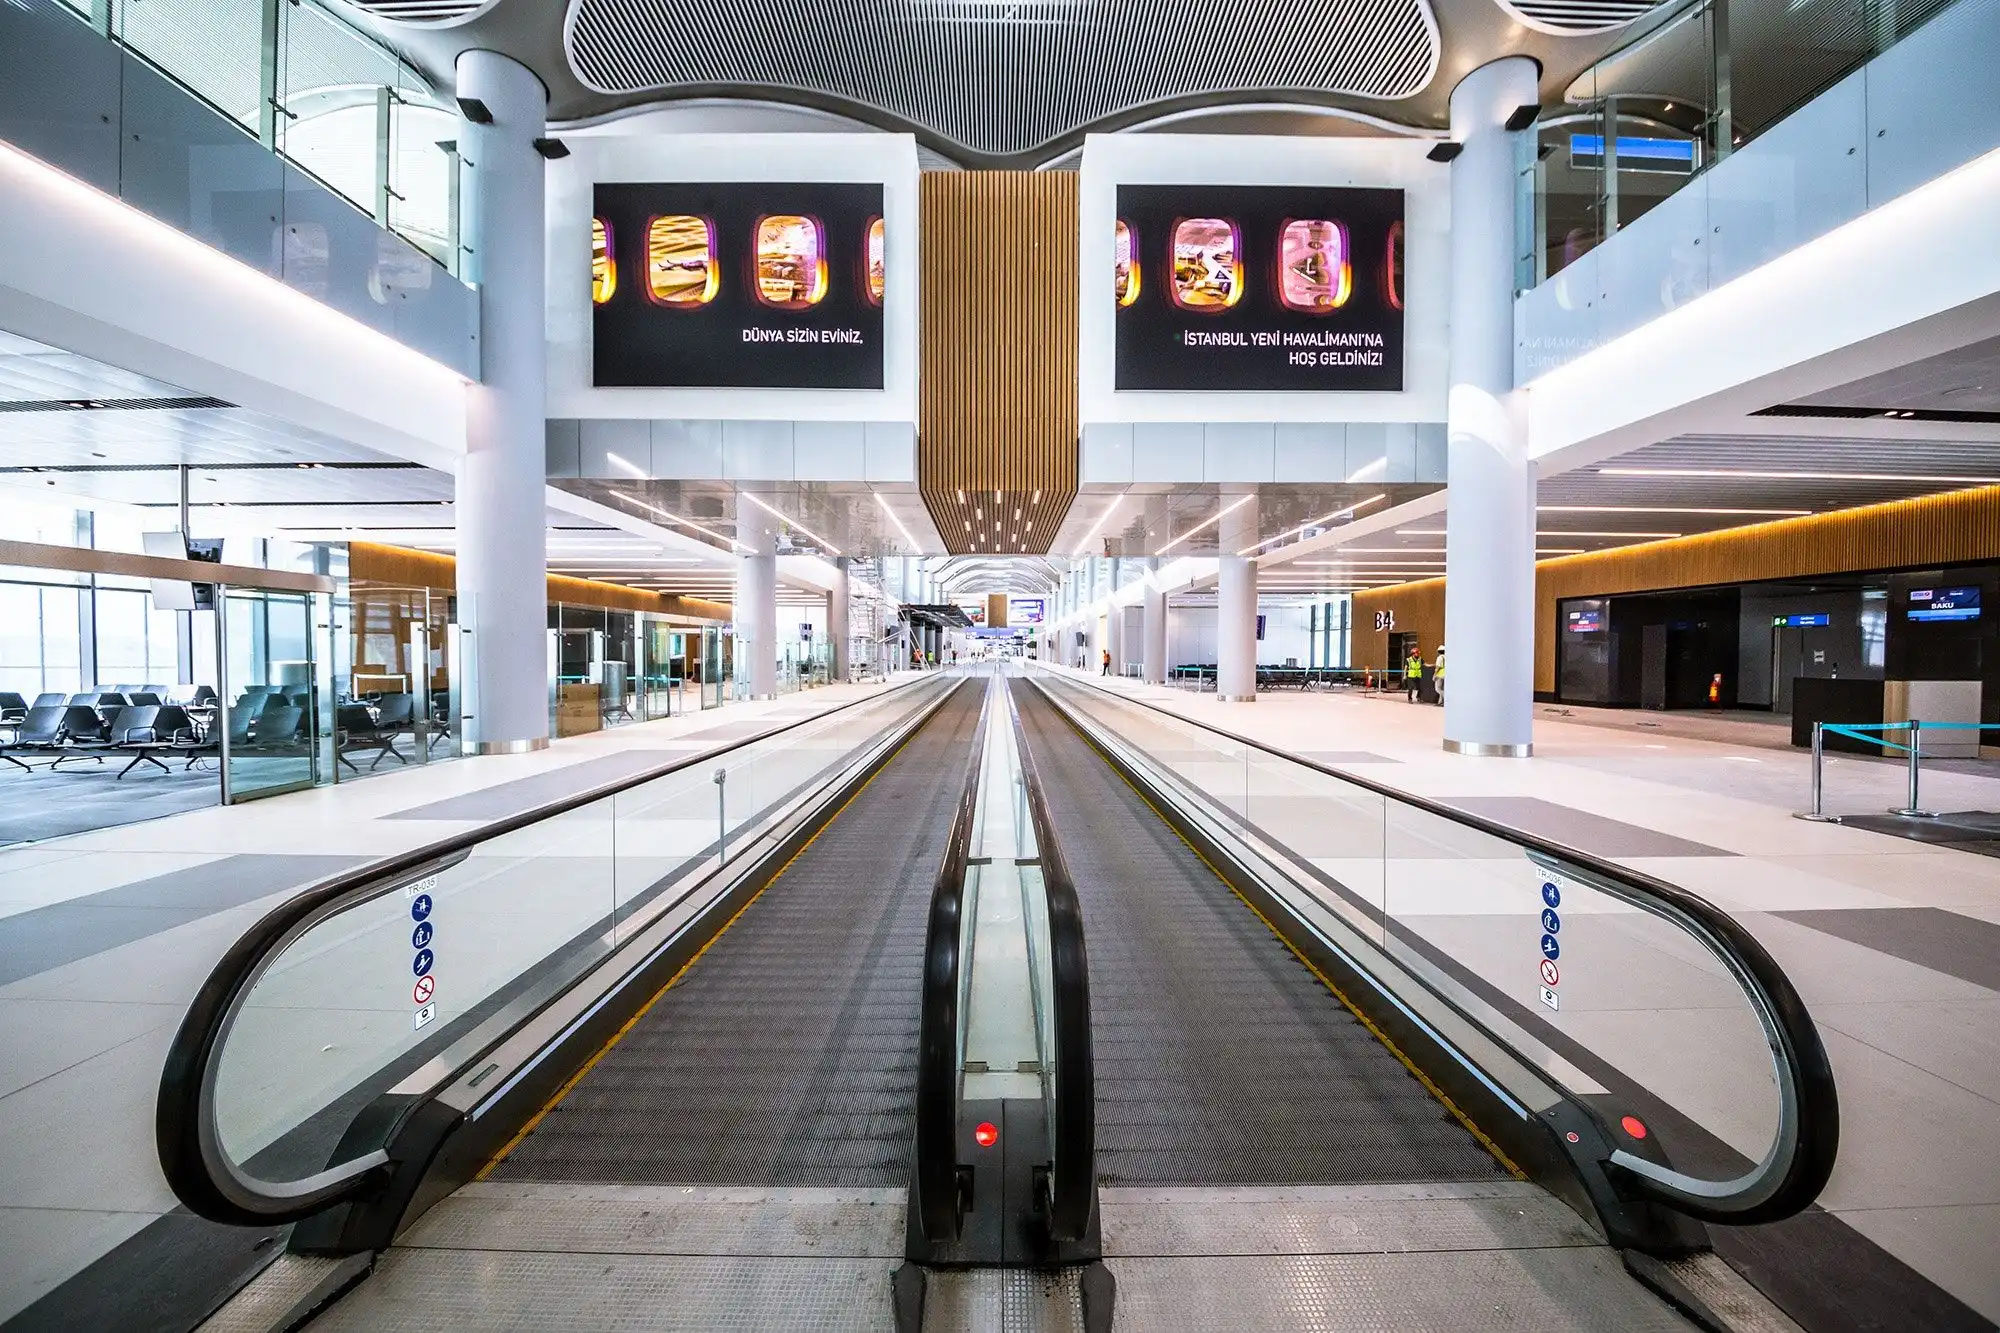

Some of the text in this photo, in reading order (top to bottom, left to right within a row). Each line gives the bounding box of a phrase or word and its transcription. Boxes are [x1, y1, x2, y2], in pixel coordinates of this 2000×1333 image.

[743, 327, 784, 342] DÜNYA
[787, 328, 819, 342] SİZİN
[1184, 330, 1248, 345] İSTANBUL
[1250, 330, 1280, 345] YENİ
[1289, 350, 1384, 367] HOŞ GELDİNİZ!
[1931, 602, 1955, 610] BAKU
[1375, 608, 1394, 631] B4
